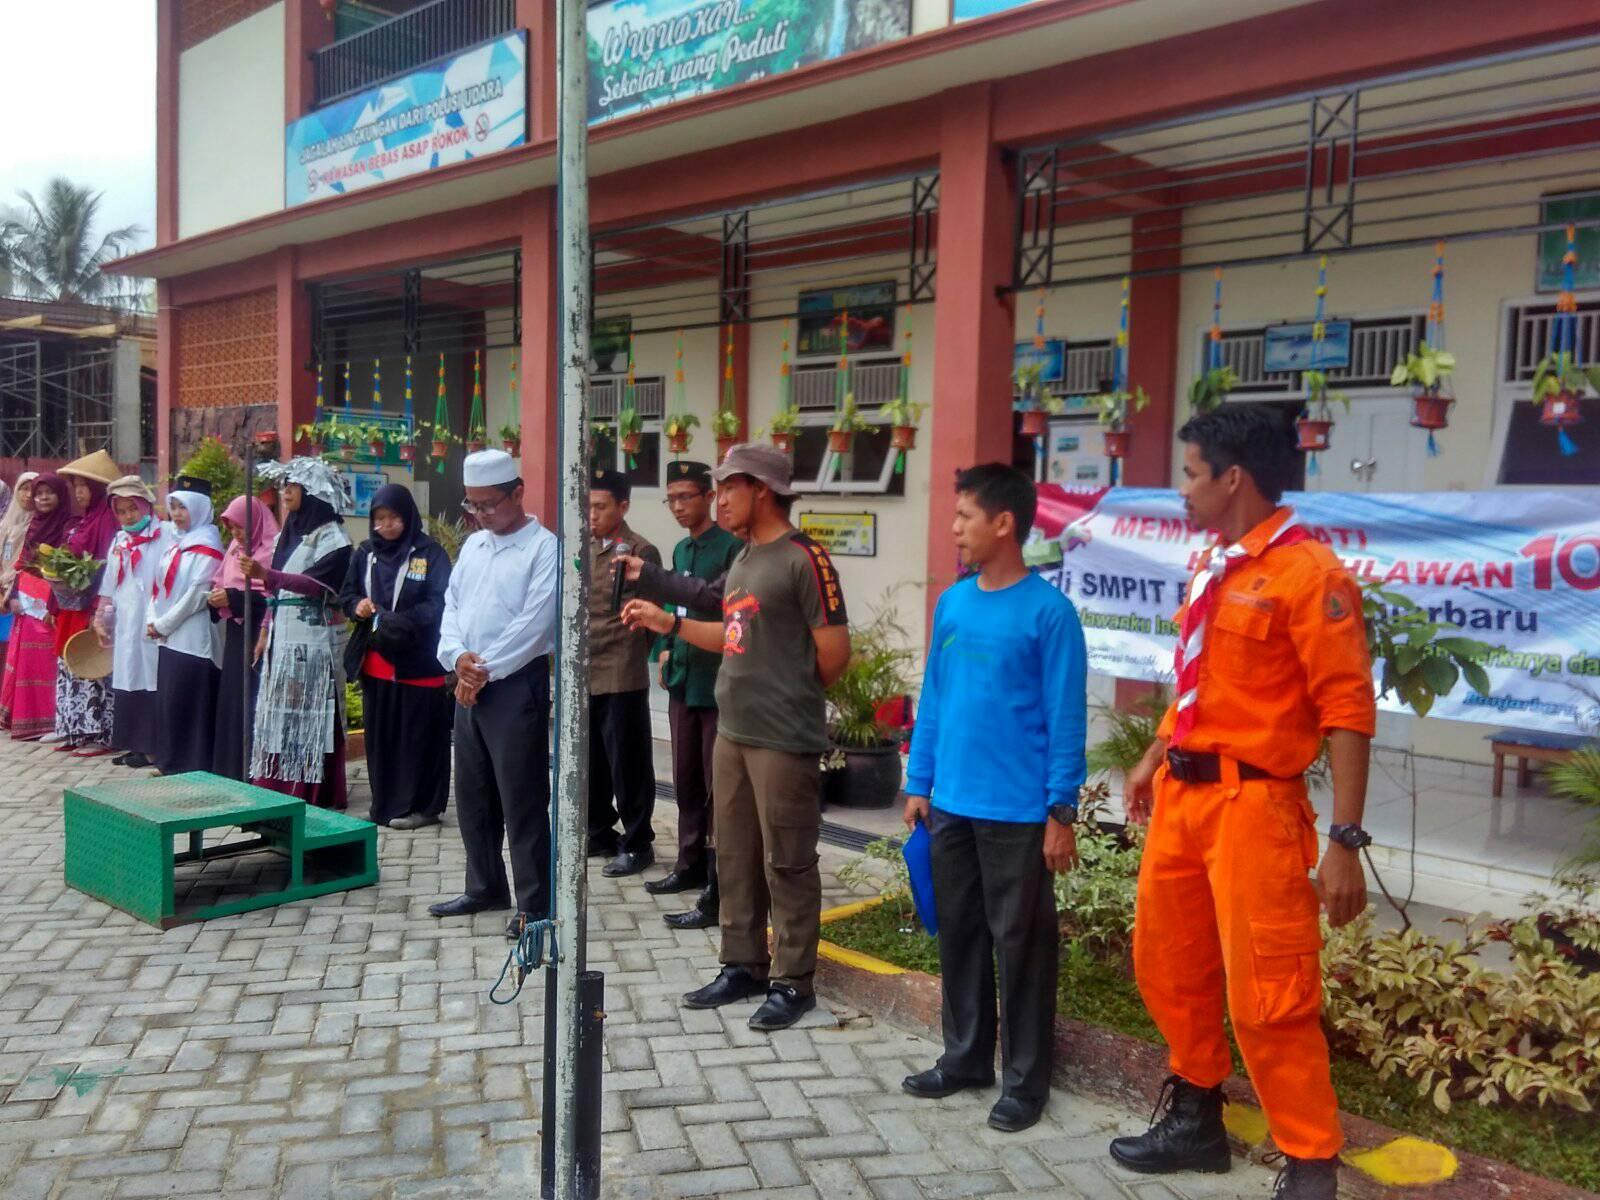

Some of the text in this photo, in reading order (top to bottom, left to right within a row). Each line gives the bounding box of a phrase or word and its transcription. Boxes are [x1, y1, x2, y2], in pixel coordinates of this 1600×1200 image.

[599, 19, 790, 106] Sekolah yang Peduli
[464, 76, 503, 109] UDARA
[402, 139, 428, 160] ASAP
[1520, 535, 1600, 591] 10
[1081, 573, 1165, 604] SMPIT
